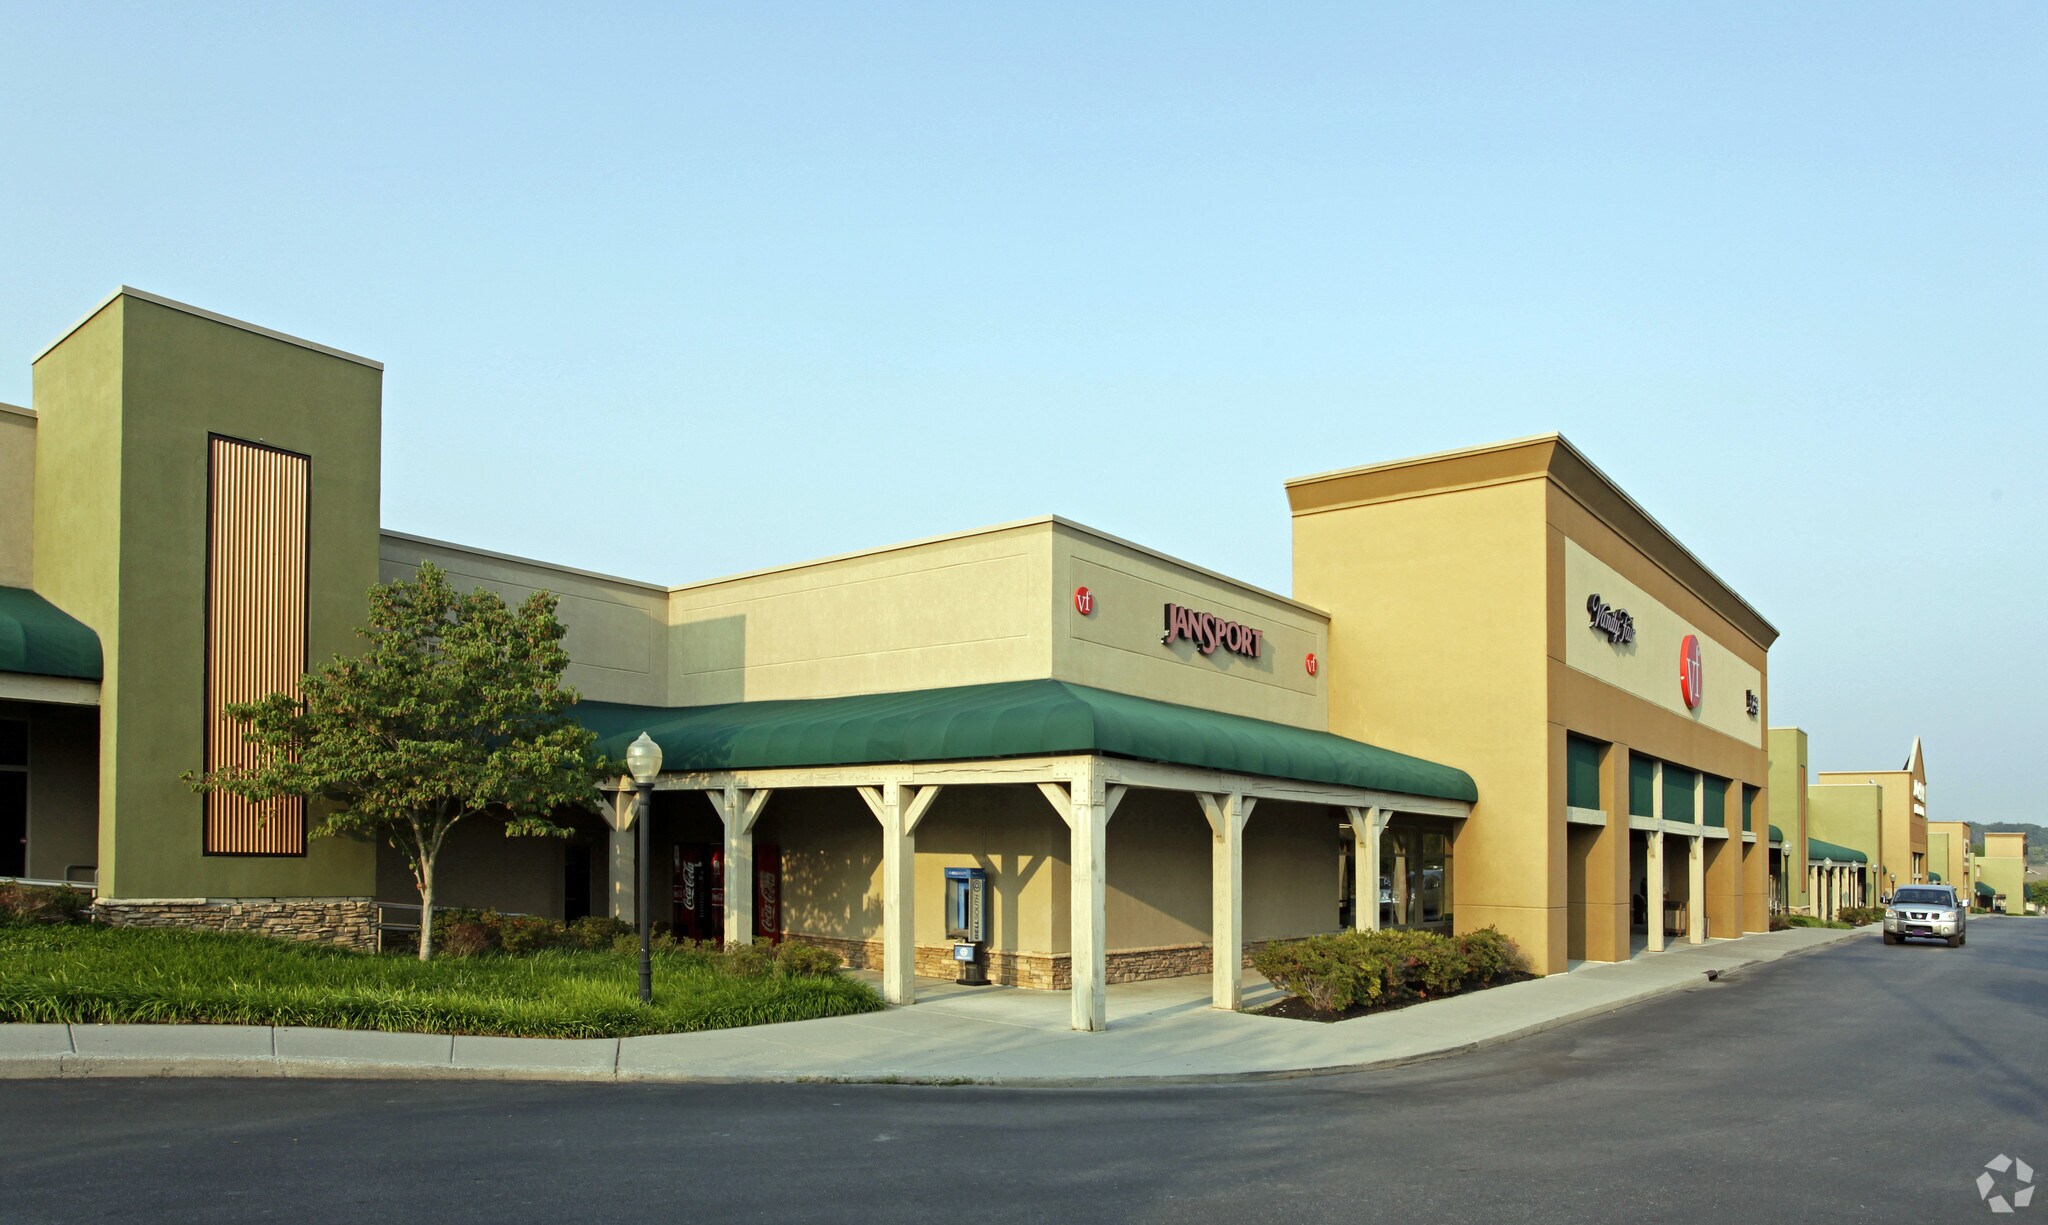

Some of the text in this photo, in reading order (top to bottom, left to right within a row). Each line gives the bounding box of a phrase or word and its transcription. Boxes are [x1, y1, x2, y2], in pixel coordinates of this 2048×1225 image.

[1077, 591, 1091, 612] vf
[1591, 594, 1620, 643] Vanity
[1164, 603, 1263, 657] JANSPORT
[1307, 656, 1316, 673] vf
[1686, 644, 1702, 703] vf
